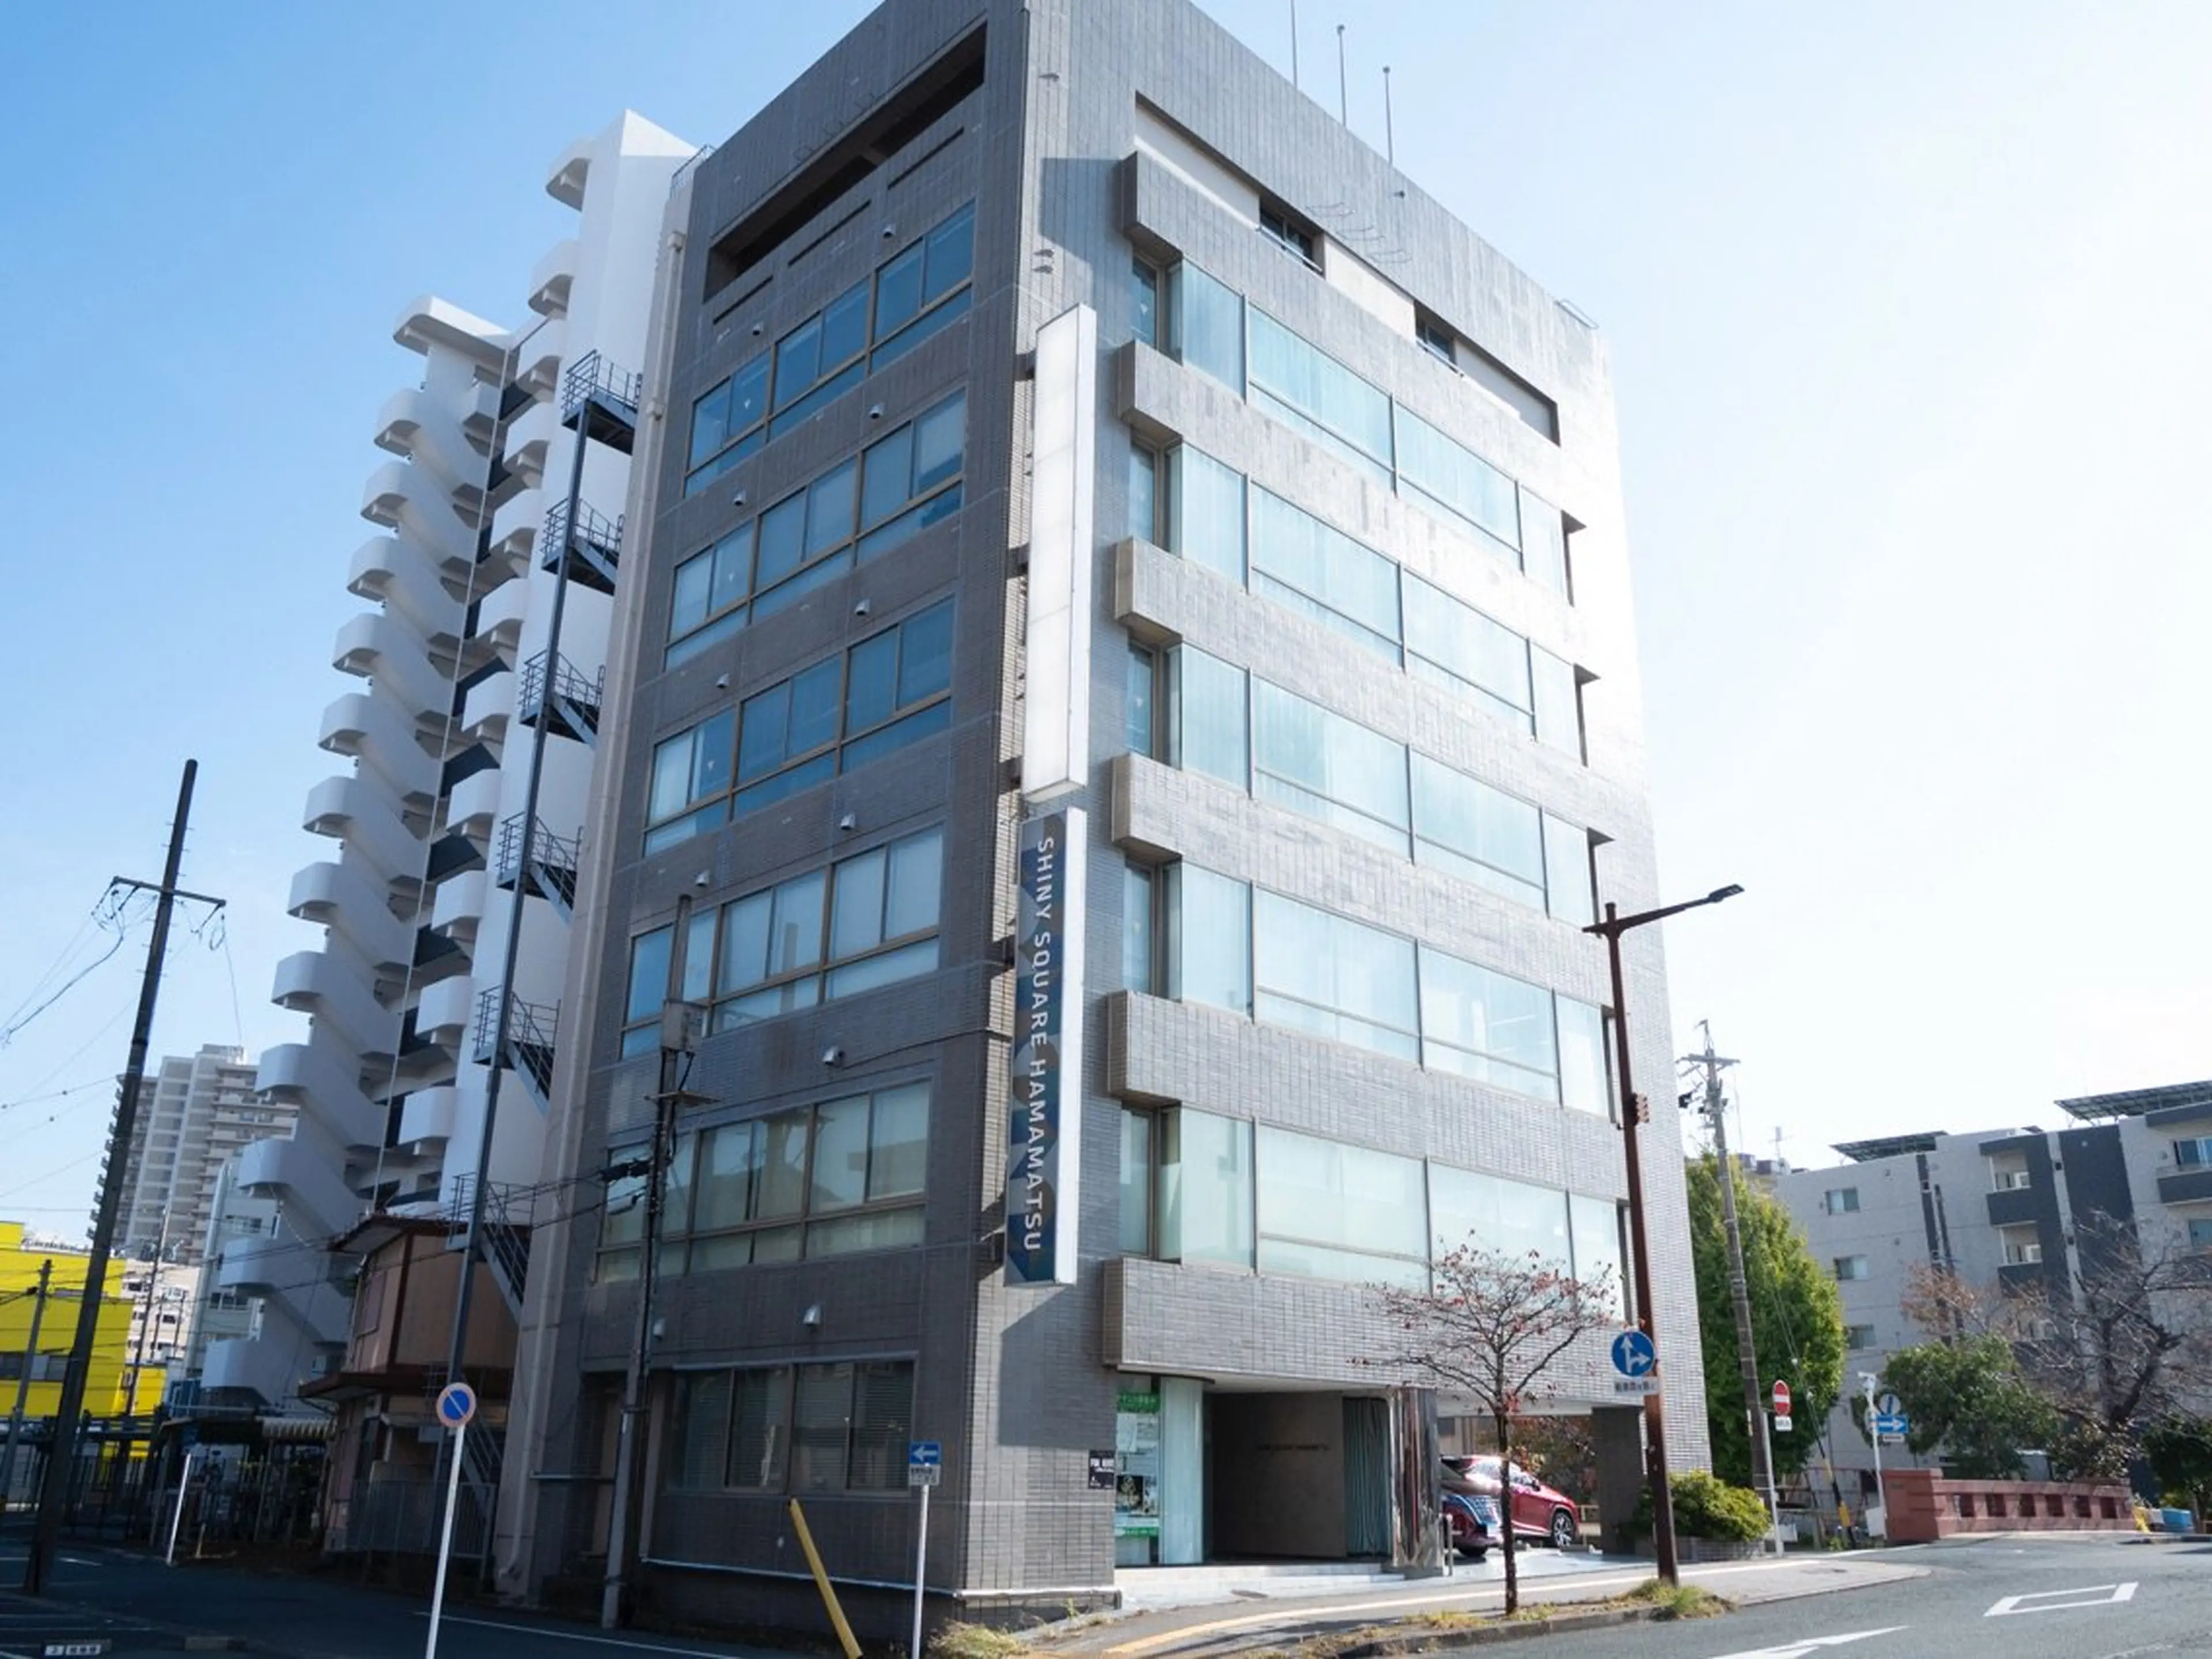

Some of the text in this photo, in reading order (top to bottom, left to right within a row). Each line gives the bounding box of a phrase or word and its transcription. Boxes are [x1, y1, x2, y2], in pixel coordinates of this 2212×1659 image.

[1024, 836, 1054, 1251] SHINY SQUARE HAMAMATSU
